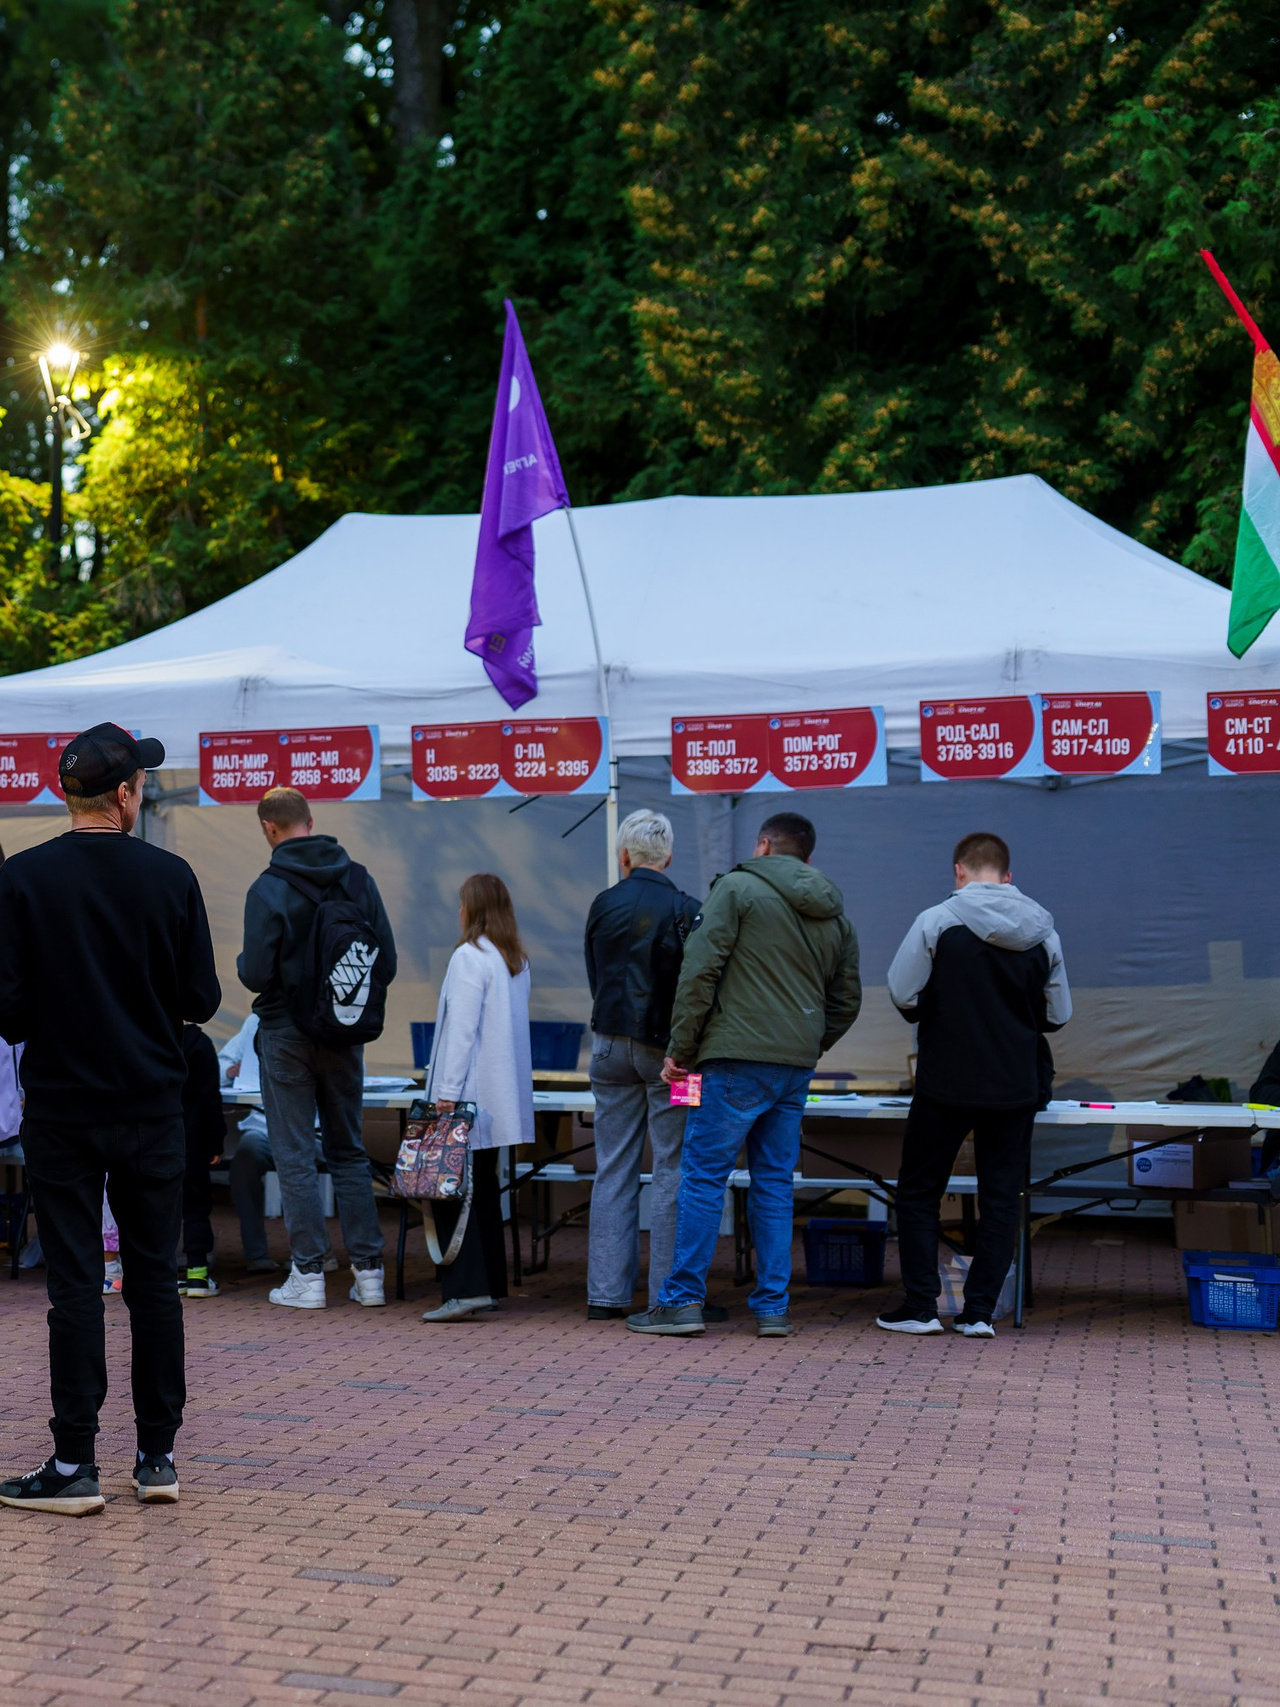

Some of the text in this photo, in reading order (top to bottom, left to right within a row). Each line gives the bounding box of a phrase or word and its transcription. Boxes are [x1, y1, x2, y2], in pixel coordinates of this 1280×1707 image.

[936, 723, 1000, 744] РОД-САЛ
[1051, 718, 1109, 736] САМ-СЛ
[1225, 716, 1272, 735] СМ-СТ
[514, 743, 545, 760] О-ПА
[686, 739, 736, 757] ПЕ-ПОЛ
[783, 734, 842, 754] ПОМ-РОГ
[937, 742, 1014, 762] 3758-3916
[1051, 738, 1130, 756] 3917-4109
[1225, 737, 1264, 755] 4110
[212, 753, 268, 770] МАЛ-МИР
[291, 750, 339, 768] МИС-МЯ
[426, 748, 436, 764] Н
[783, 752, 857, 772] 3573-3757
[426, 766, 458, 782] 3035
[468, 763, 500, 780] 3223
[514, 761, 546, 777] 3224
[557, 760, 589, 776] 3395
[686, 757, 758, 776] 3396-3572
[212, 771, 275, 788] 2667-2857
[291, 769, 321, 786] 2858
[331, 768, 361, 784] 3034
